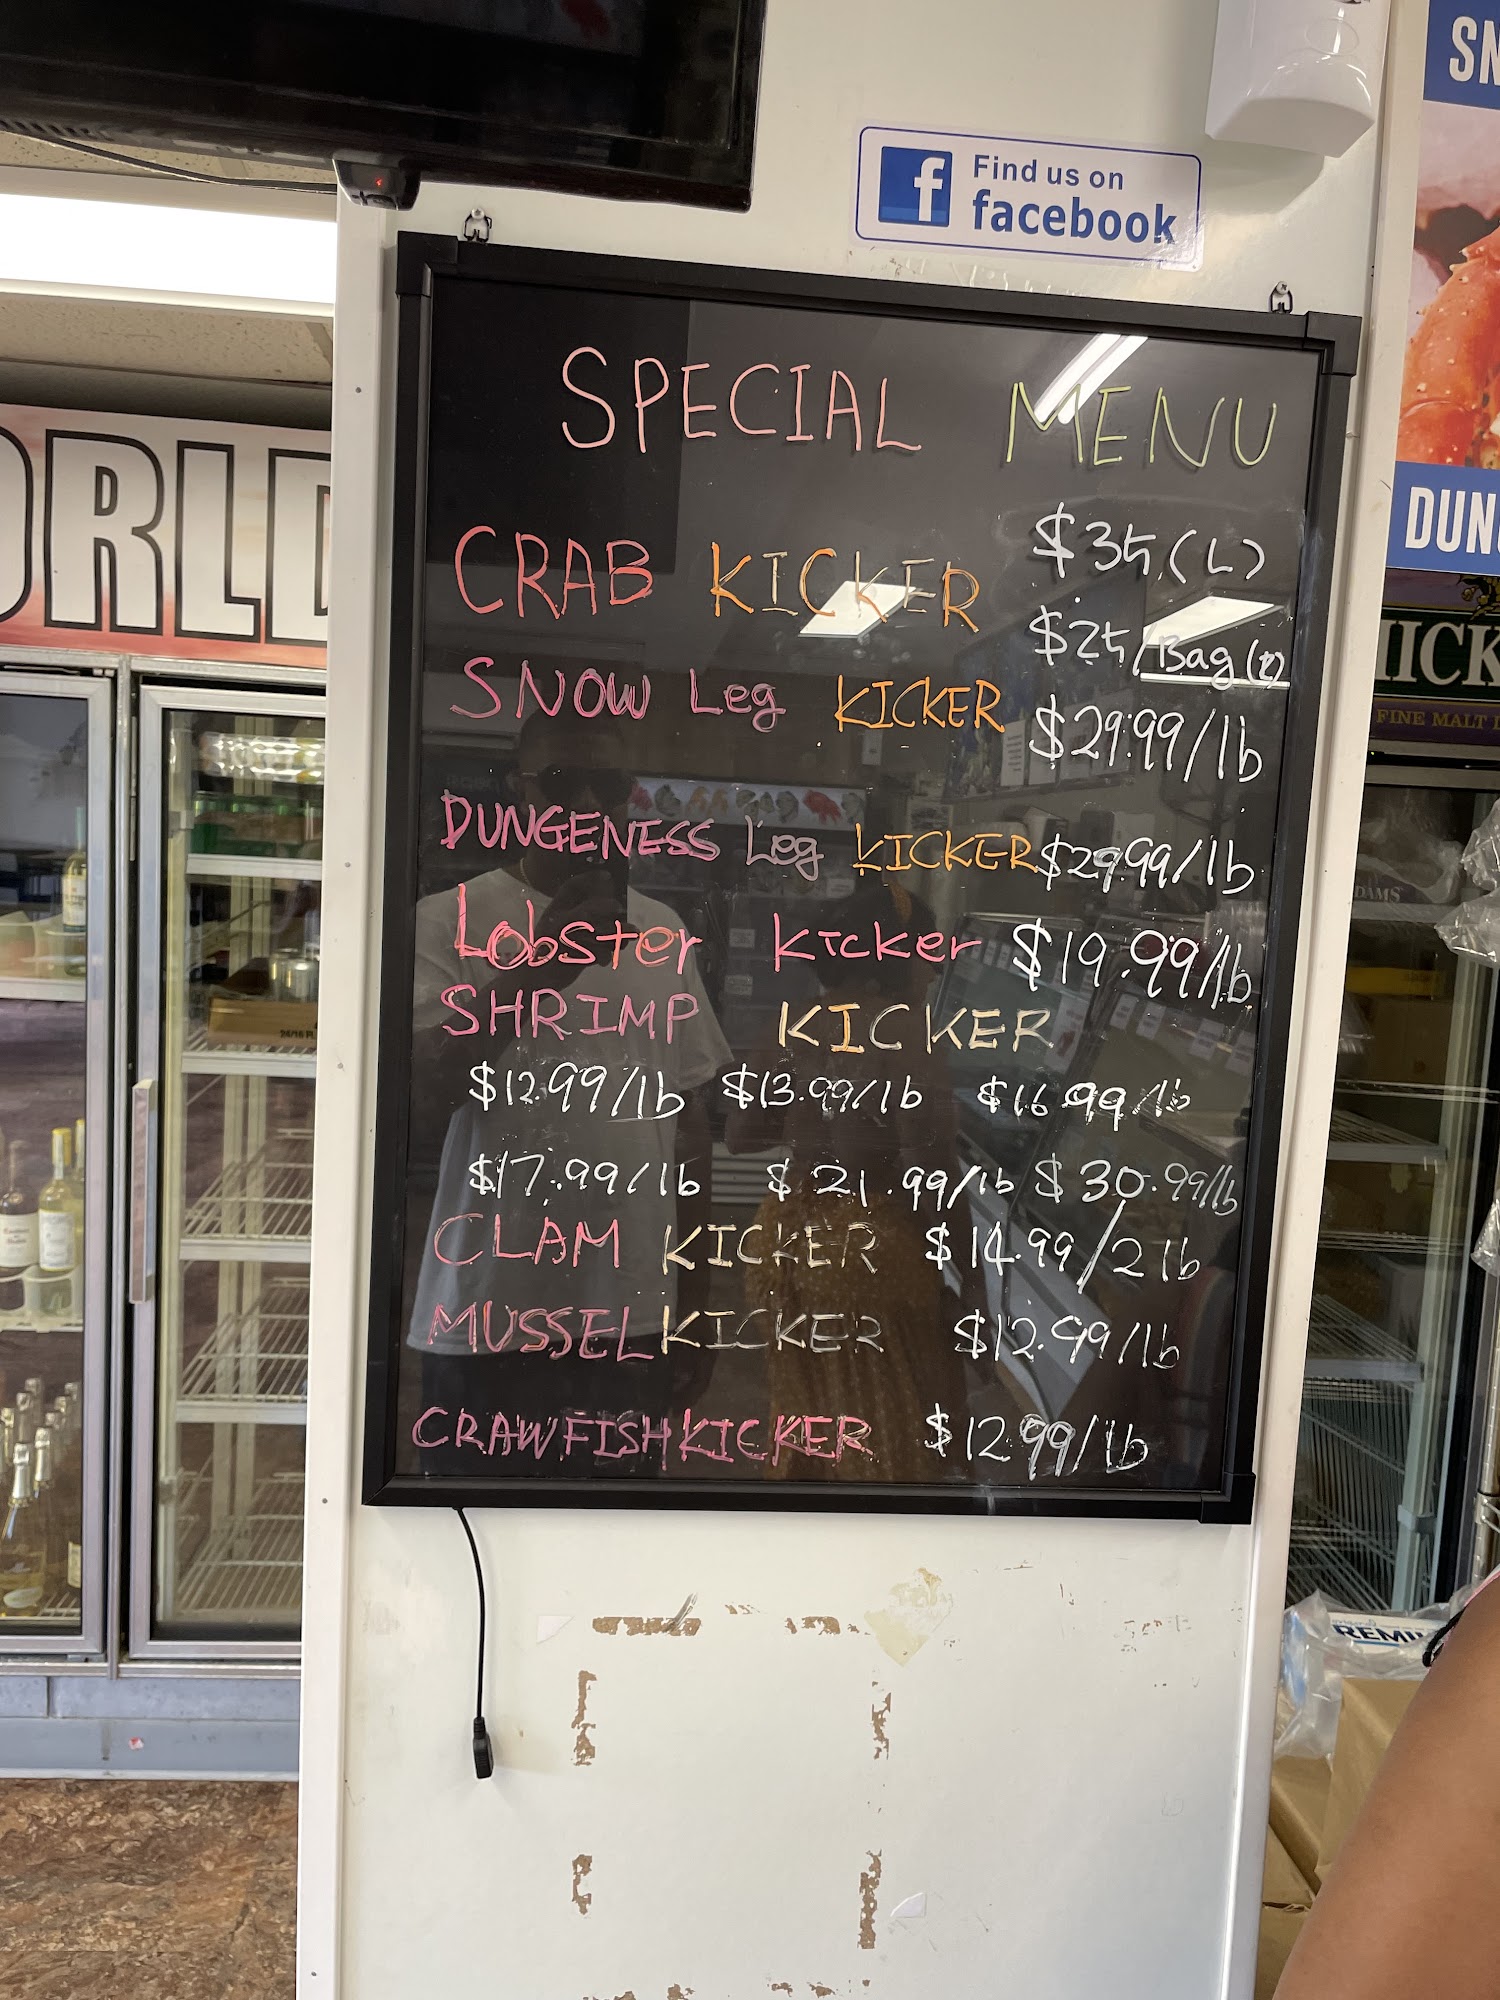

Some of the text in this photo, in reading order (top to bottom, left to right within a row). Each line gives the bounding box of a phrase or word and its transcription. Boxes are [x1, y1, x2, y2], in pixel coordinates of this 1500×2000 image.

[973, 154, 1124, 190] Find us on
[972, 189, 1176, 245] facebook
[562, 346, 1277, 467] SPECIAL MENU
[1405, 486, 1500, 555] DUN
[455, 525, 653, 619] CRAB
[711, 541, 981, 632] KICKER
[450, 655, 1263, 783] SNOW Leg KICKER $29.99/lb
[1376, 708, 1425, 726] FINE
[1431, 711, 1487, 729] MALT
[440, 789, 1255, 894] DUNGENESS Leg KICKER $29.99/lb
[455, 883, 702, 975] Lobster
[1013, 917, 1252, 1009] $19.99/lb
[440, 984, 1055, 1054] SHRIMP KICKER
[469, 1061, 686, 1119] $12.99/lb
[722, 1063, 922, 1119] $13.99/lb
[469, 1150, 701, 1199] $17.99/lb
[434, 1212, 620, 1268] CLAM
[662, 1221, 877, 1275] KICKER
[427, 1302, 1180, 1368] MUSSEL KICKER $12.99/lb
